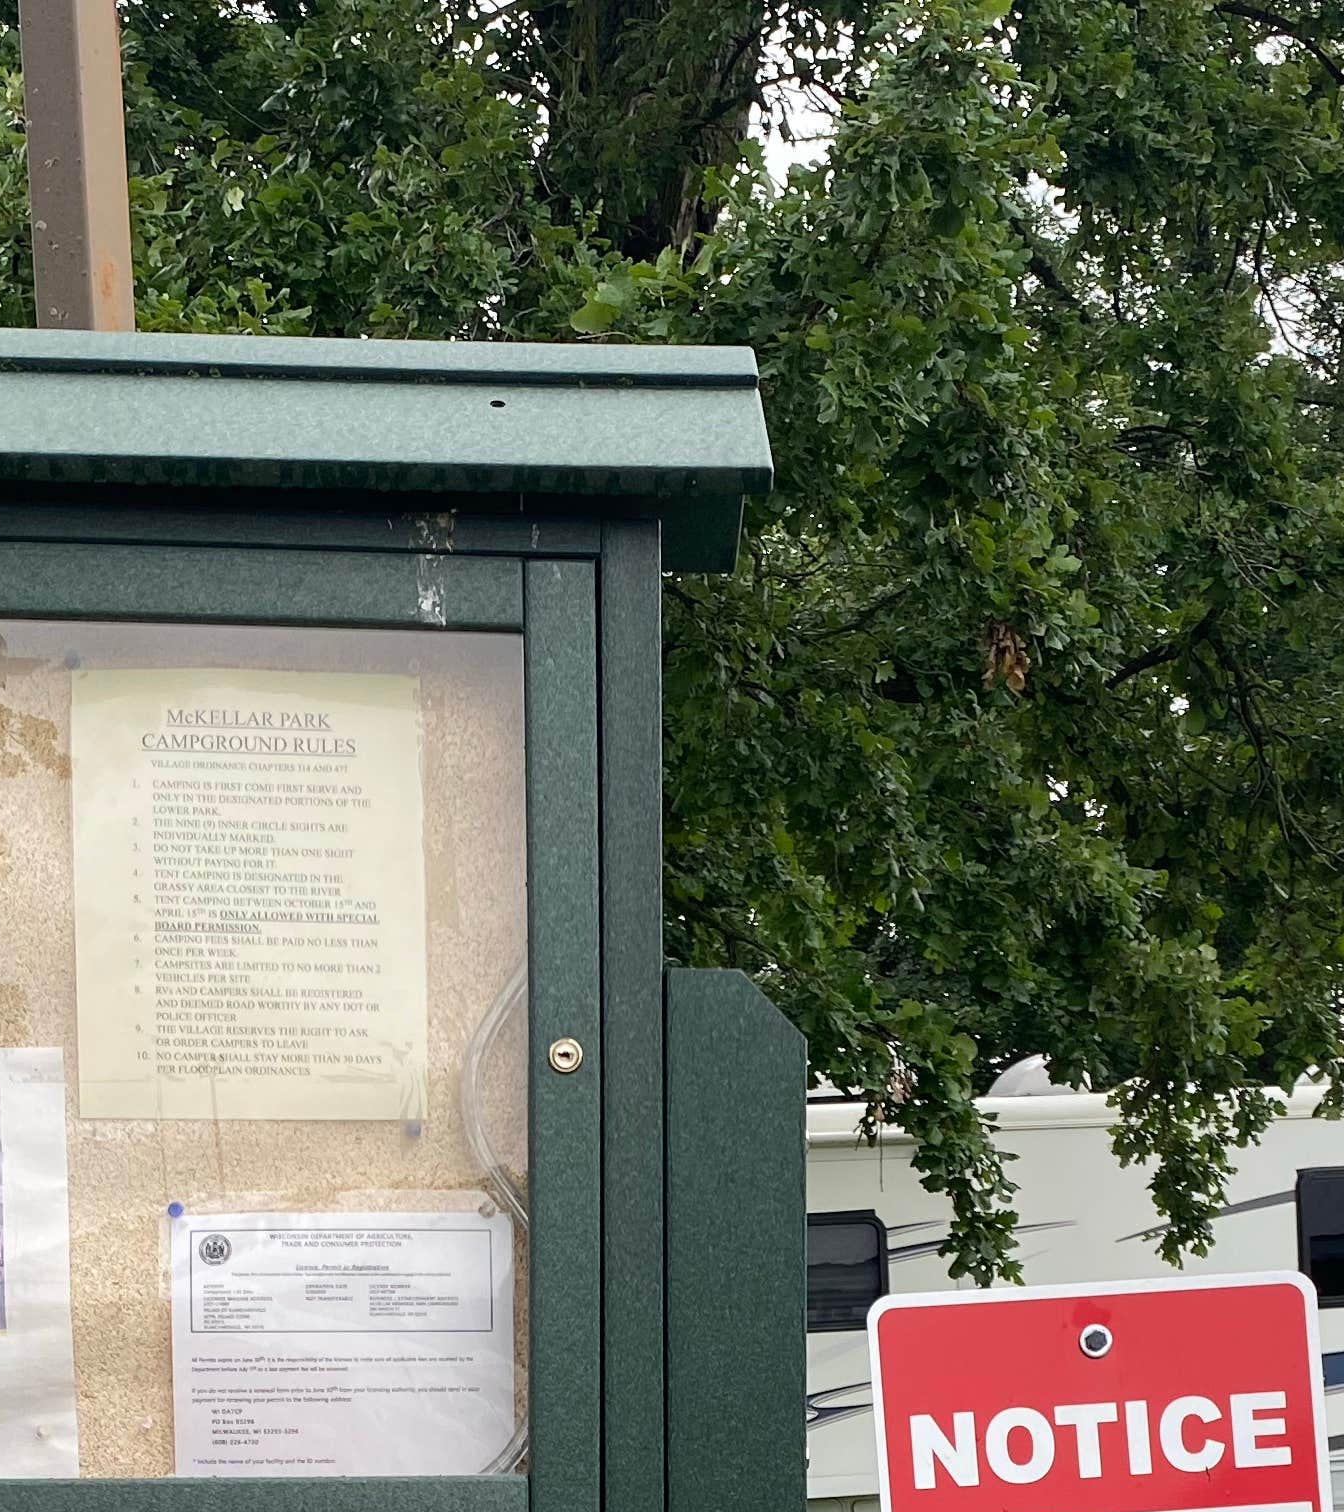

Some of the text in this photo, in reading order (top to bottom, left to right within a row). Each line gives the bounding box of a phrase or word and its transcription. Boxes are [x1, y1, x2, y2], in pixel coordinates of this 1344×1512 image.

[167, 709, 331, 728] McKELLAR PARK
[142, 733, 356, 753] CAMPGROUND RULES
[153, 806, 190, 815] LOWER
[153, 832, 227, 842] INDIVIDUALLY
[154, 921, 192, 932] BOARD
[909, 1391, 1292, 1490] NOTICE
